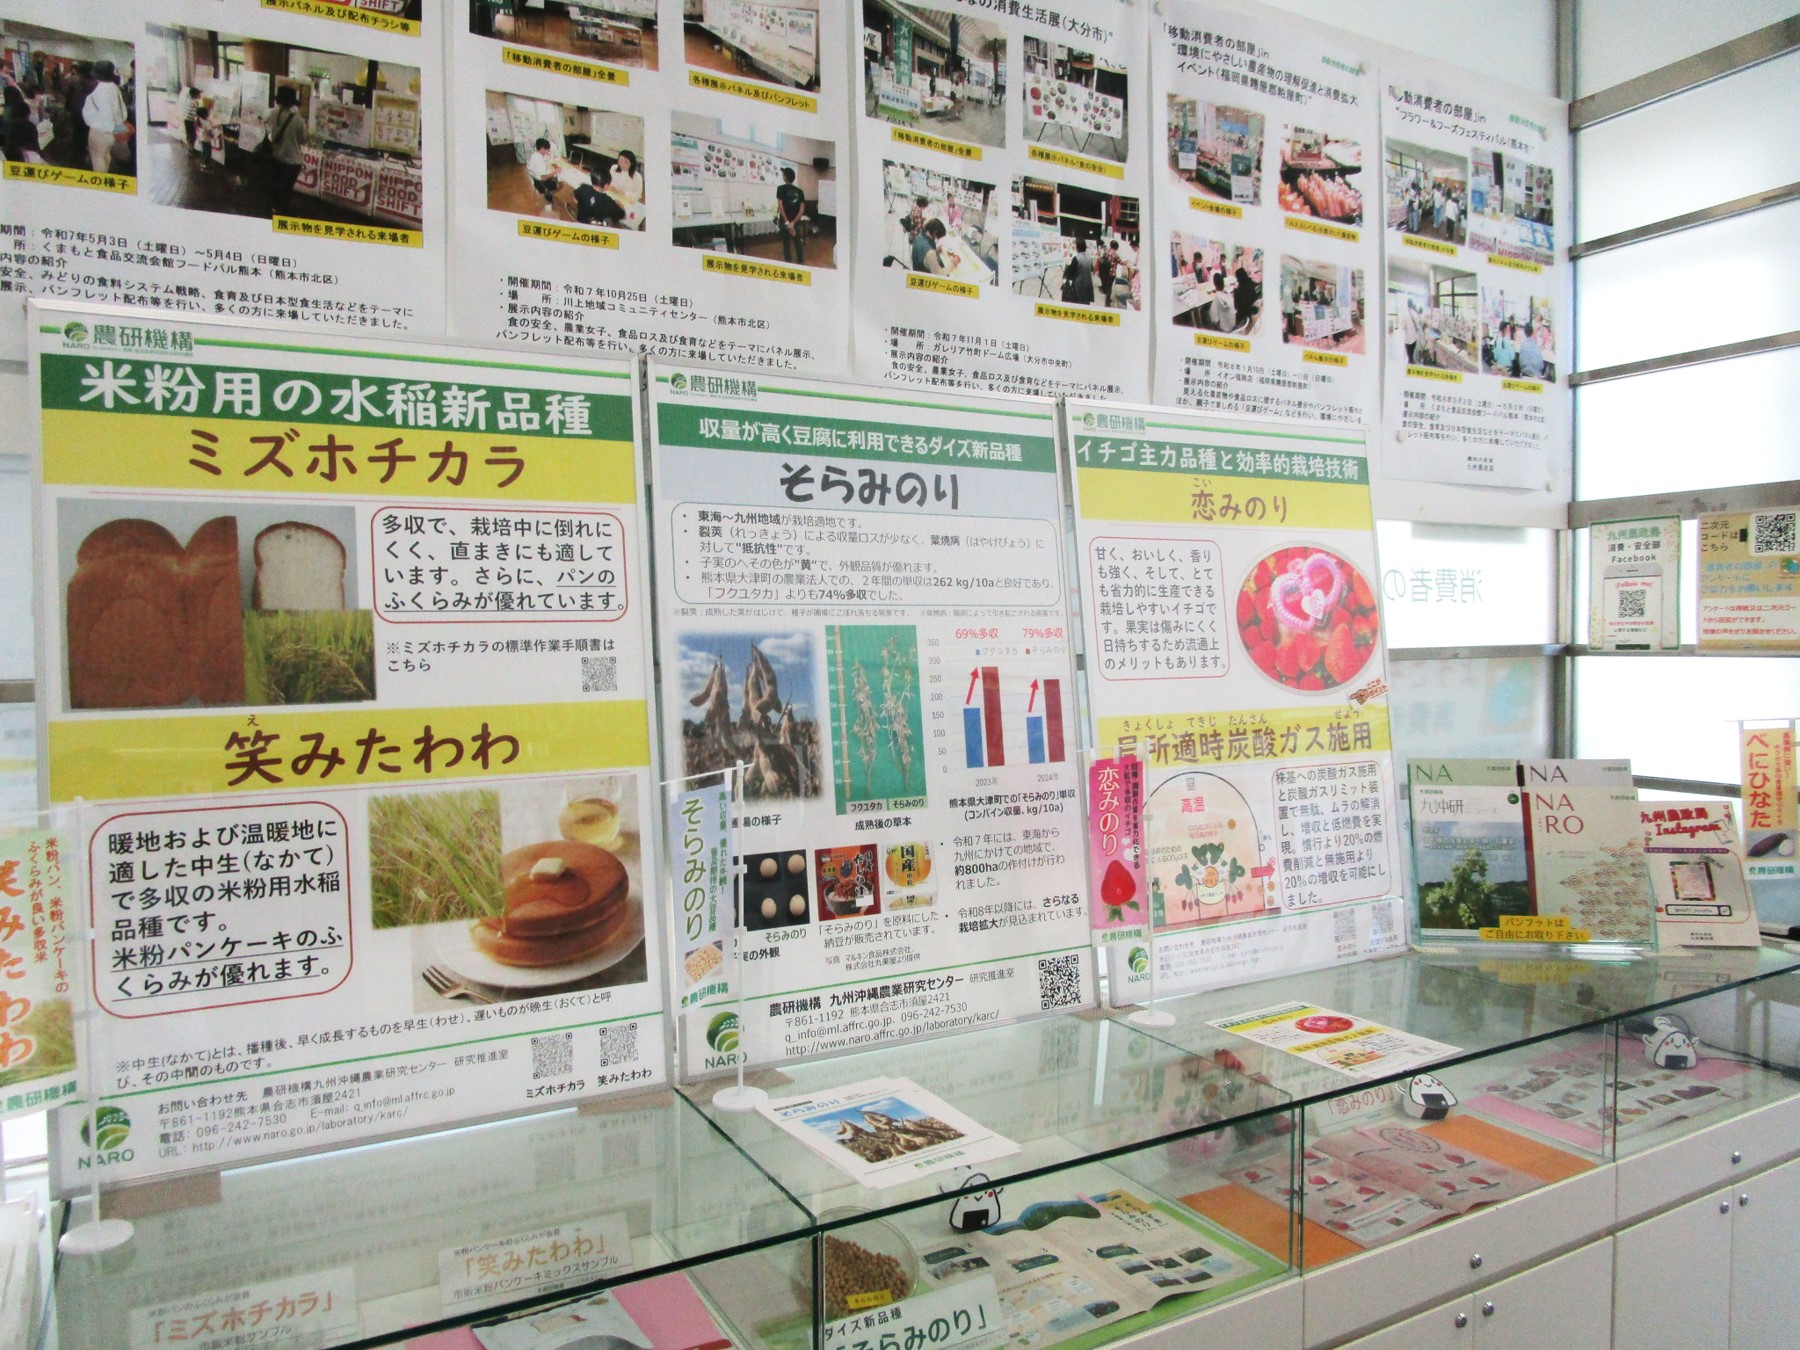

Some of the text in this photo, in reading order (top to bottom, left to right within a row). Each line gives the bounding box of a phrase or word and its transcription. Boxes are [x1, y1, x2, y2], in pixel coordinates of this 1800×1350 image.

[9, 165, 130, 190] 豆運びゲームの様子
[324, 173, 358, 186] FOOD
[325, 161, 373, 181] NIPPON
[323, 181, 361, 200] SHIFT
[379, 185, 417, 202] FOOD
[377, 196, 422, 215] SHIFT
[278, 220, 409, 243] 展示物を見学される来場者
[522, 225, 610, 245] 豆運びゲームの様子
[0, 253, 68, 269] 内容の紹介
[707, 259, 804, 283] 展示物を見学される来場者
[93, 324, 193, 351] 農研機構
[690, 375, 757, 398] 農研機構
[79, 360, 592, 435] 米粉用の水稲新品種
[1096, 413, 1146, 432] 農研機構
[699, 417, 1023, 462] 収量が高く豆腐に利用できるダイズ新品種
[189, 427, 525, 488] ミズホチカラ
[1078, 439, 1359, 480] イチゴ主力品種と効率的栽培技術
[779, 462, 959, 511] そらみのり
[1192, 477, 1212, 488] こい
[1190, 489, 1288, 523] 恋みのり
[382, 514, 612, 539] 多収で、栽培中に倒れに
[1701, 520, 1729, 530] 二次元
[1701, 531, 1738, 540] コードは
[386, 541, 613, 562] くく、直まきにも適して
[1095, 546, 1212, 564] 甘く、おいしく、香り
[1701, 543, 1728, 552] こちら
[1611, 553, 1657, 563] Facebook
[384, 566, 615, 587] います。さらに、パンの
[1097, 565, 1214, 580] も強く、そして、とて
[1099, 583, 1215, 599] も省力的に生産できる
[384, 591, 625, 611] ふくらみが優れています。
[1099, 601, 1217, 616] 栽培しやすいイチゴで
[955, 627, 1064, 639] 69%多収 79%多収
[1101, 619, 1217, 635] す。果実は傷みにくく
[386, 638, 615, 655] ※ミズホチカラの標準作業手順書は
[927, 638, 940, 647] 350
[1103, 637, 1220, 653] 日持ちするため流通上
[388, 659, 431, 673] こちら
[928, 657, 941, 665] 300
[1104, 654, 1226, 671] のメリットもあります。
[929, 675, 942, 683] 250
[930, 693, 943, 701] 200
[247, 714, 259, 726] え
[932, 711, 944, 719] 150
[1122, 713, 1268, 731] きょくしょ てきじ たんさん
[933, 729, 946, 738] 100
[224, 722, 520, 787] 笑みたわわ
[938, 748, 947, 756] 50
[942, 765, 948, 774] 0
[1275, 764, 1377, 785] 株基への炭酸ガス施用
[1416, 764, 1453, 781] NA
[1530, 764, 1568, 782] NA
[975, 772, 1060, 787] 2023年 2024年
[1185, 777, 1196, 791] 昼
[1746, 733, 1771, 828] べにひなた
[1278, 781, 1379, 802] と炭酸ガスリミット装
[851, 799, 925, 813] フクユタカ そらみのり
[1097, 766, 1121, 856] 恋みのり
[1181, 796, 1205, 814] 高温
[1277, 796, 1380, 820] 置で無駄、ムラの解消
[1536, 793, 1575, 811] NA
[855, 816, 912, 831] 成熟後の草本
[1281, 814, 1382, 837] し、増収と低燃費を実
[1545, 815, 1584, 834] RO
[1640, 807, 1709, 825] 九州農政局
[107, 818, 338, 856] 暖地および温暖地に
[1654, 821, 1722, 839] Instagram
[954, 842, 1057, 862] 九州にかけての地域で、
[1281, 831, 1383, 856] 現。慣行より20%の燃
[108, 844, 335, 884] 適した中生(なかて)
[681, 798, 706, 941] そらみのり
[1283, 848, 1374, 873] 費削減と無施用より
[955, 876, 1001, 891] れました。
[1284, 864, 1386, 890] 20%の増収を可能にし
[111, 870, 341, 911] で多収の米粉用水稲
[1288, 890, 1324, 908] ました。
[112, 911, 229, 943] 品種です。
[958, 906, 1088, 934] 栽培拡大が見込まれています。
[765, 928, 806, 943] そらみのり
[824, 926, 935, 949] 納豆が販売されています。
[1485, 928, 1584, 941] ご自由にお取り下さい
[112, 926, 343, 970] 米粉パンケーキのふ
[117, 954, 330, 998] くらみが優れます。
[769, 996, 821, 1018] 農研機構
[830, 975, 964, 1007] 九州沖縄農業研究センター
[117, 1056, 274, 1089] び、その中間のものです。
[158, 1091, 249, 1115] お問い合わせ先
[454, 1049, 509, 1067] 研究推進室
[526, 1069, 653, 1099] ミズホチカラ 笑みたわわ
[196, 1113, 287, 1138] 096-242-7530
[465, 1234, 605, 1279] 「笑みたわわ」
[154, 1290, 333, 1344] 「ミズホチカラ」
[824, 1306, 903, 1341] ダイズ新品種
